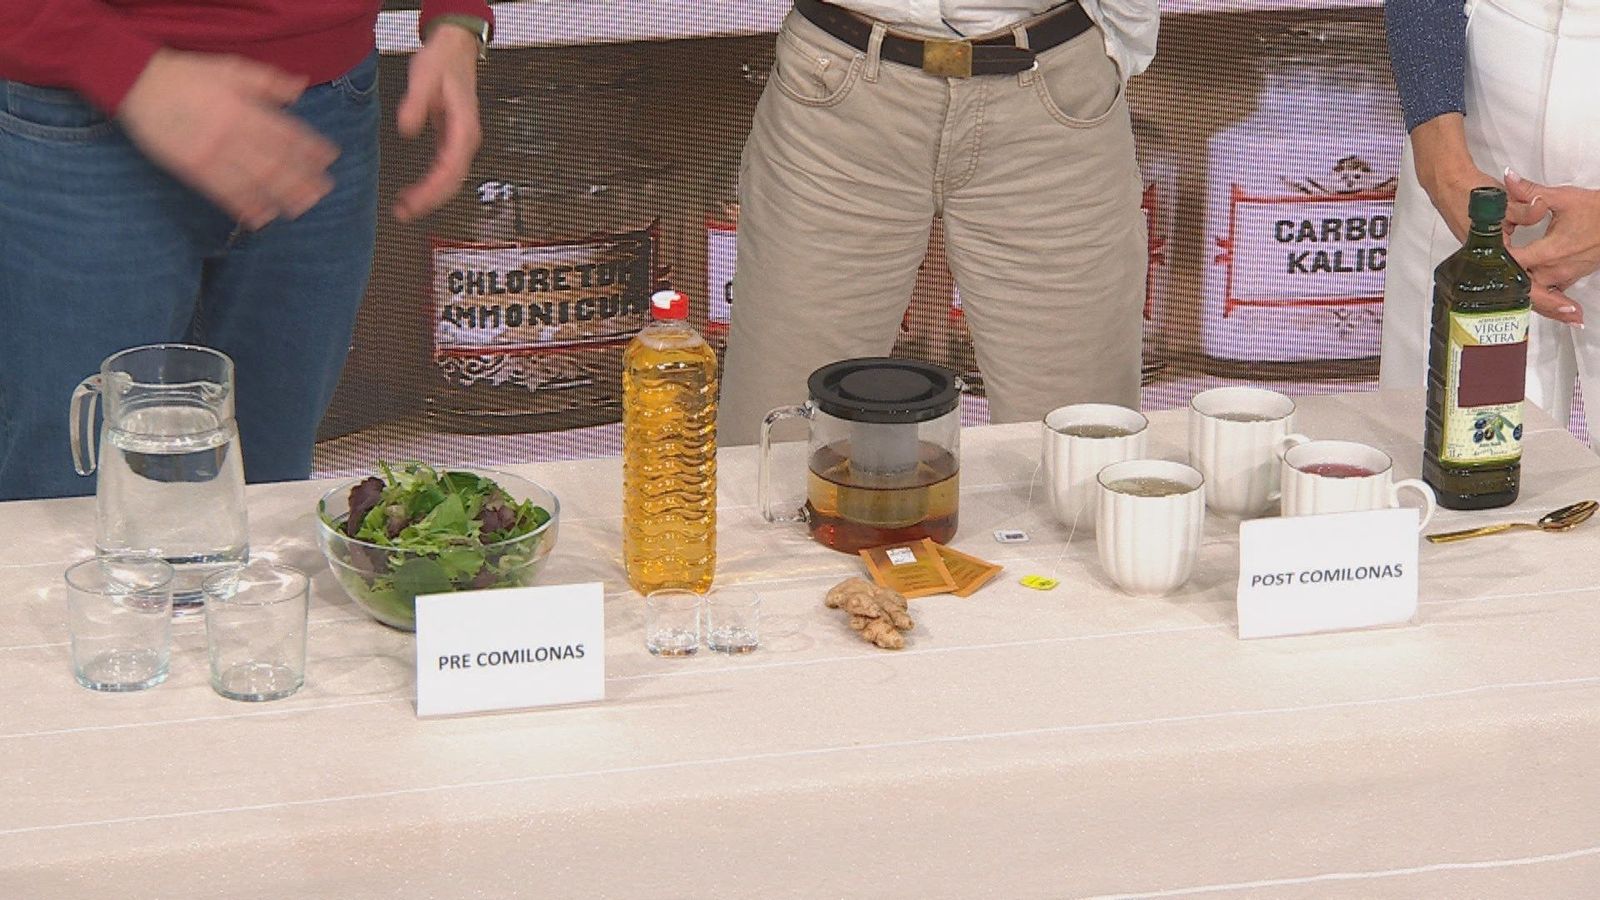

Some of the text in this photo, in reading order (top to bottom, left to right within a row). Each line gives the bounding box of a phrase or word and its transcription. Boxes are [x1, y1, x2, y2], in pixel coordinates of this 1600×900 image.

[1286, 247, 1388, 274] KALIC
[1473, 320, 1520, 335] VIRGEN
[1479, 332, 1515, 345] EXTRA
[1251, 562, 1404, 588] POST COMILONAS
[438, 642, 586, 671] PRE COMILONAS
